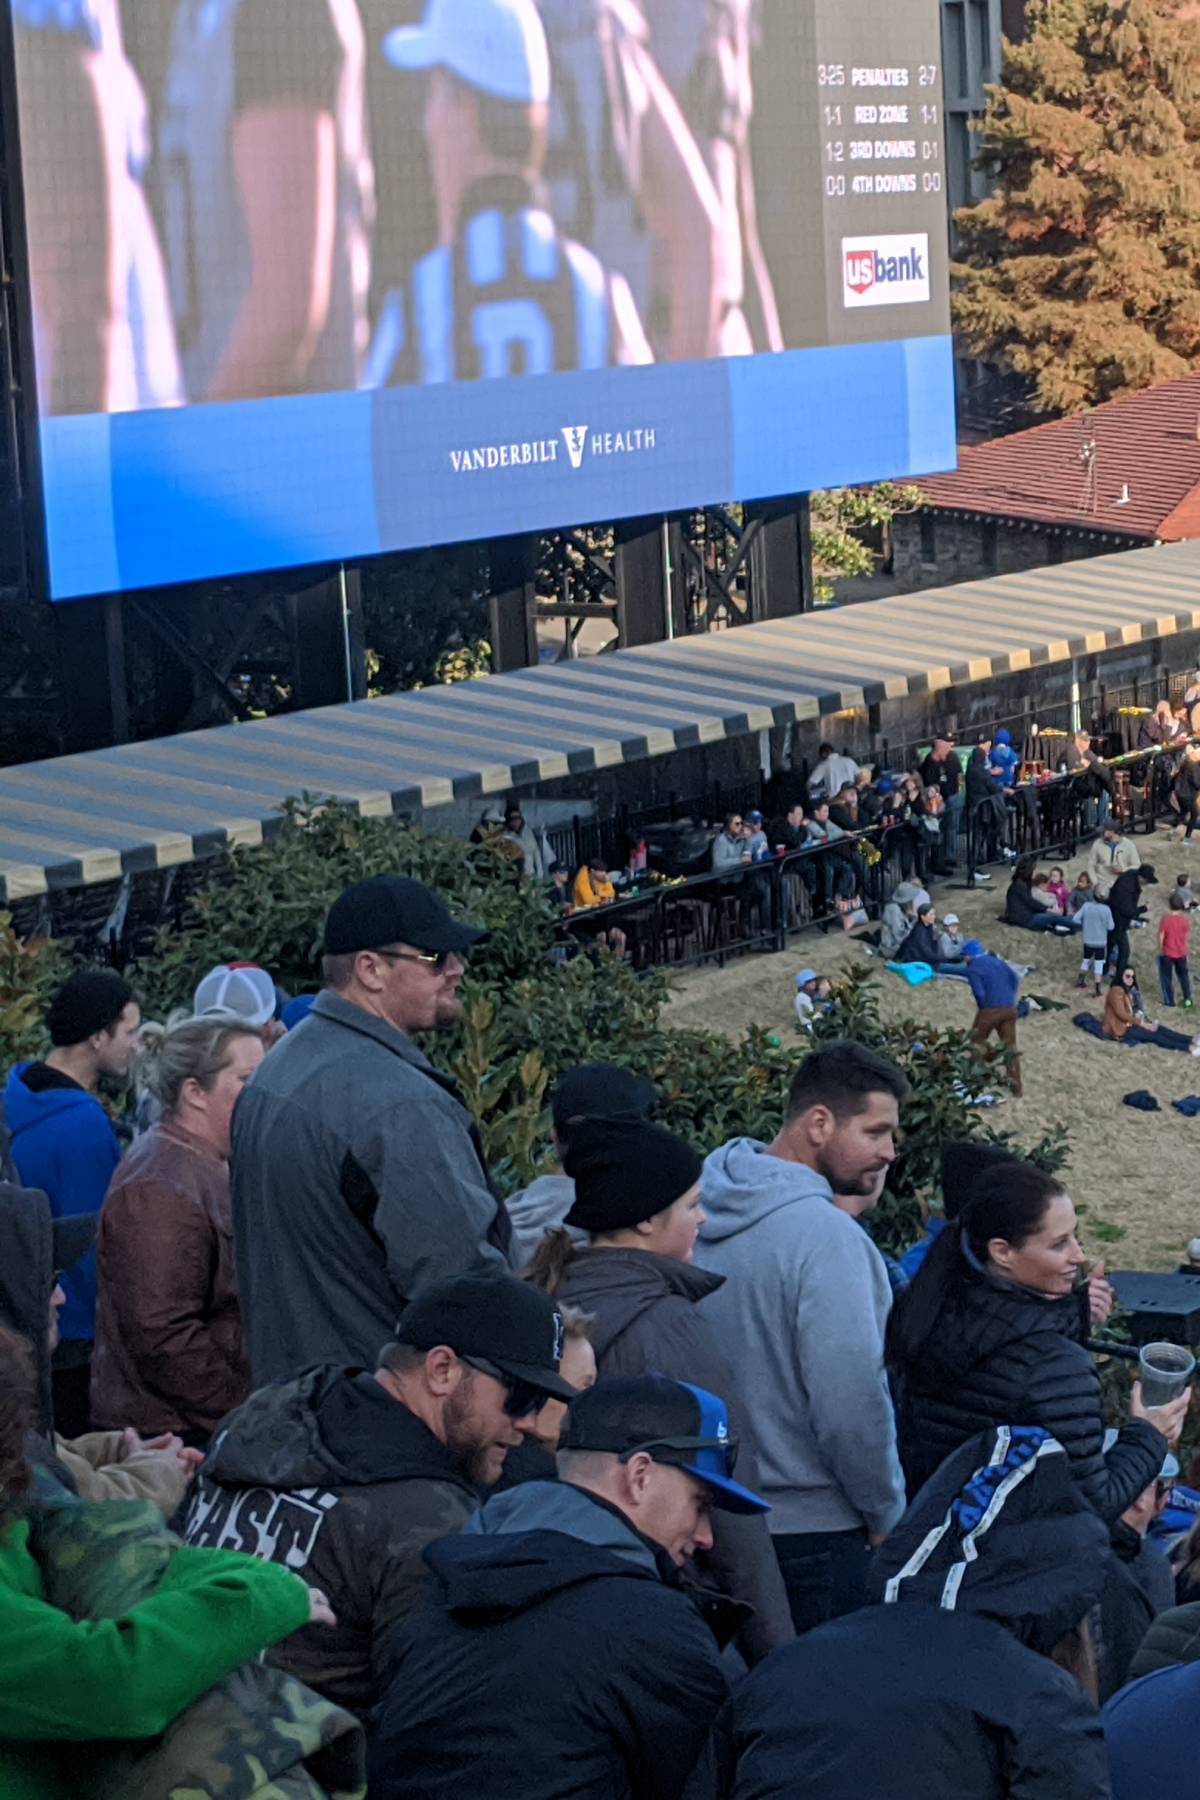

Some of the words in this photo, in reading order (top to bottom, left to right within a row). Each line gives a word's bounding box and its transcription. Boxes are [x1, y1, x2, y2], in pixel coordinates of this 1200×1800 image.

[851, 67, 909, 87] PENALTIES
[823, 105, 842, 126] 1-1
[854, 105, 878, 124] RED
[878, 104, 909, 124] ZONE
[921, 105, 937, 125] 1-1
[849, 140, 873, 160] 3RD
[874, 140, 917, 159] DOWNS
[826, 175, 846, 196] 0-0
[852, 175, 873, 193] 4TH
[874, 174, 917, 193] DOWNS
[922, 172, 941, 193] 0-0
[450, 439, 559, 473] VANDERBILT
[591, 428, 656, 455] HEALTH
[185, 1487, 324, 1569] AST
